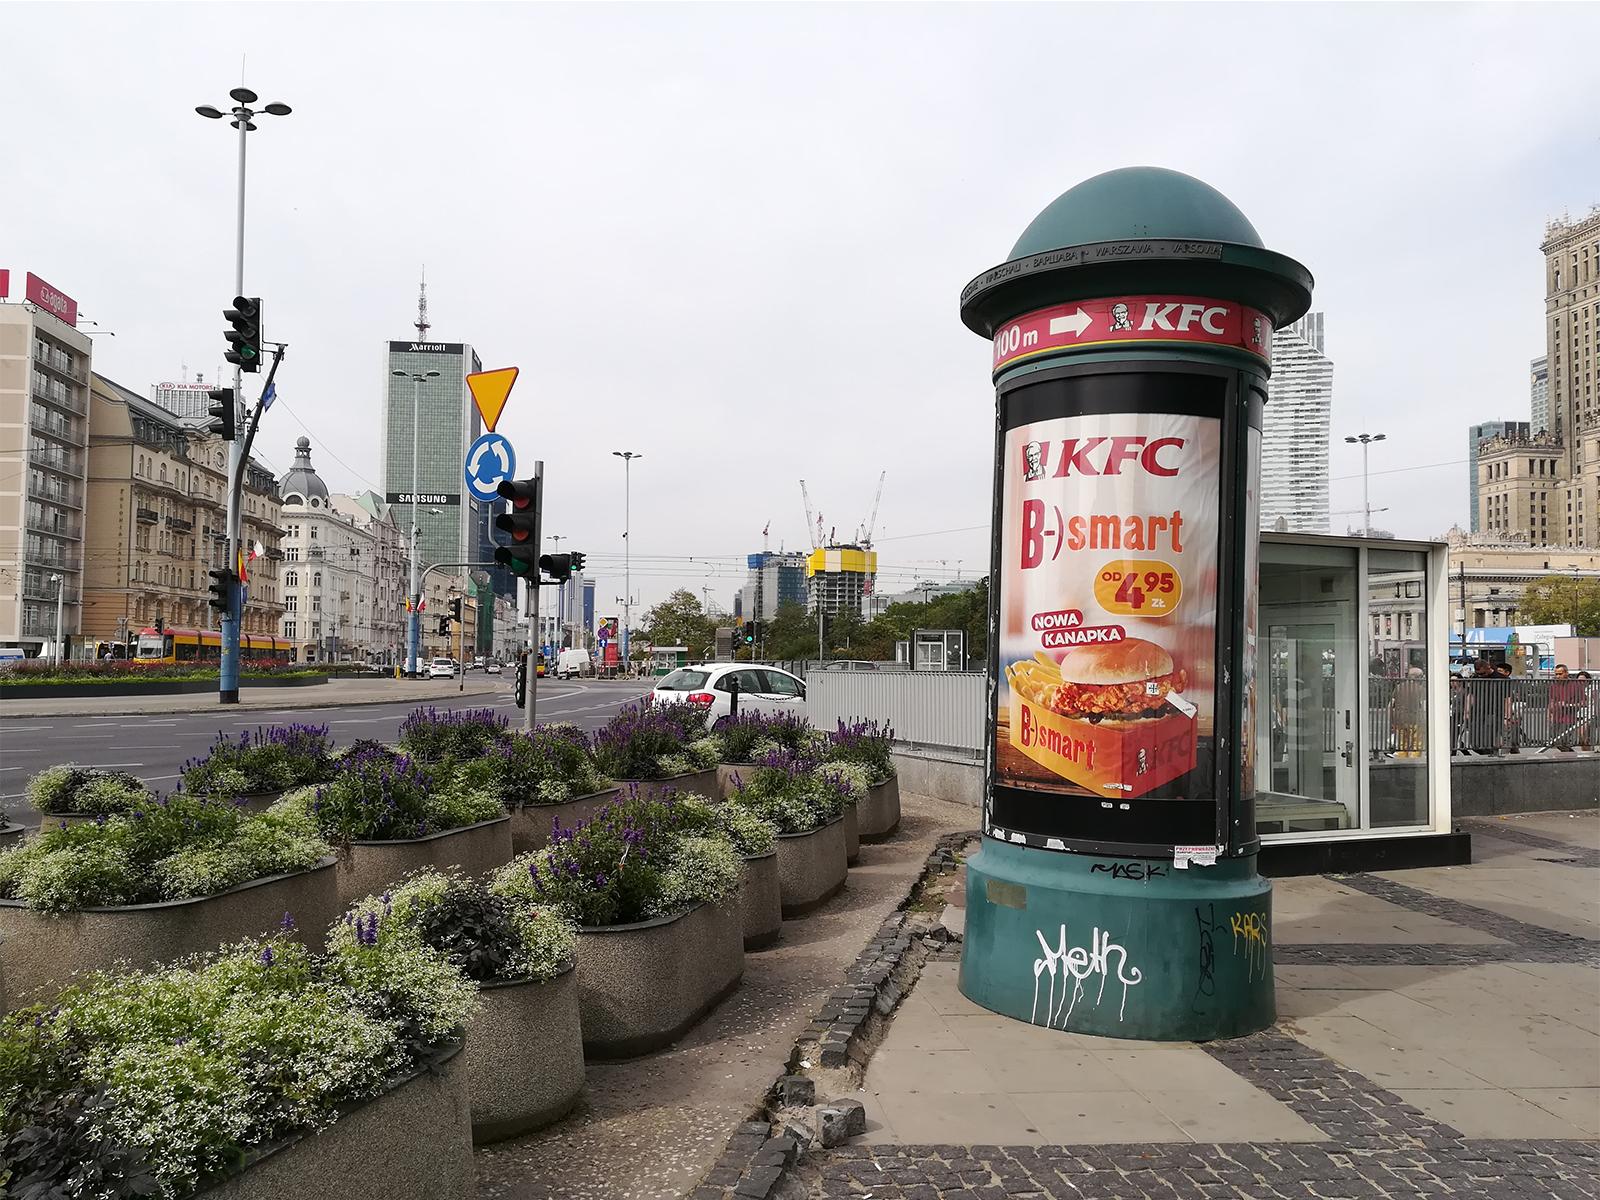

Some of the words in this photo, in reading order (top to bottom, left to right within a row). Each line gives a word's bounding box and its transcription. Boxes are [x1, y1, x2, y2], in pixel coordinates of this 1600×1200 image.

[994, 324, 1021, 360] 100
[1023, 328, 1039, 348] m
[1138, 303, 1228, 335] KFC
[1052, 436, 1185, 478] KFC
[1101, 571, 1122, 582] OD
[1033, 612, 1080, 630] NOWA
[1044, 628, 1122, 647] KANAPKA
